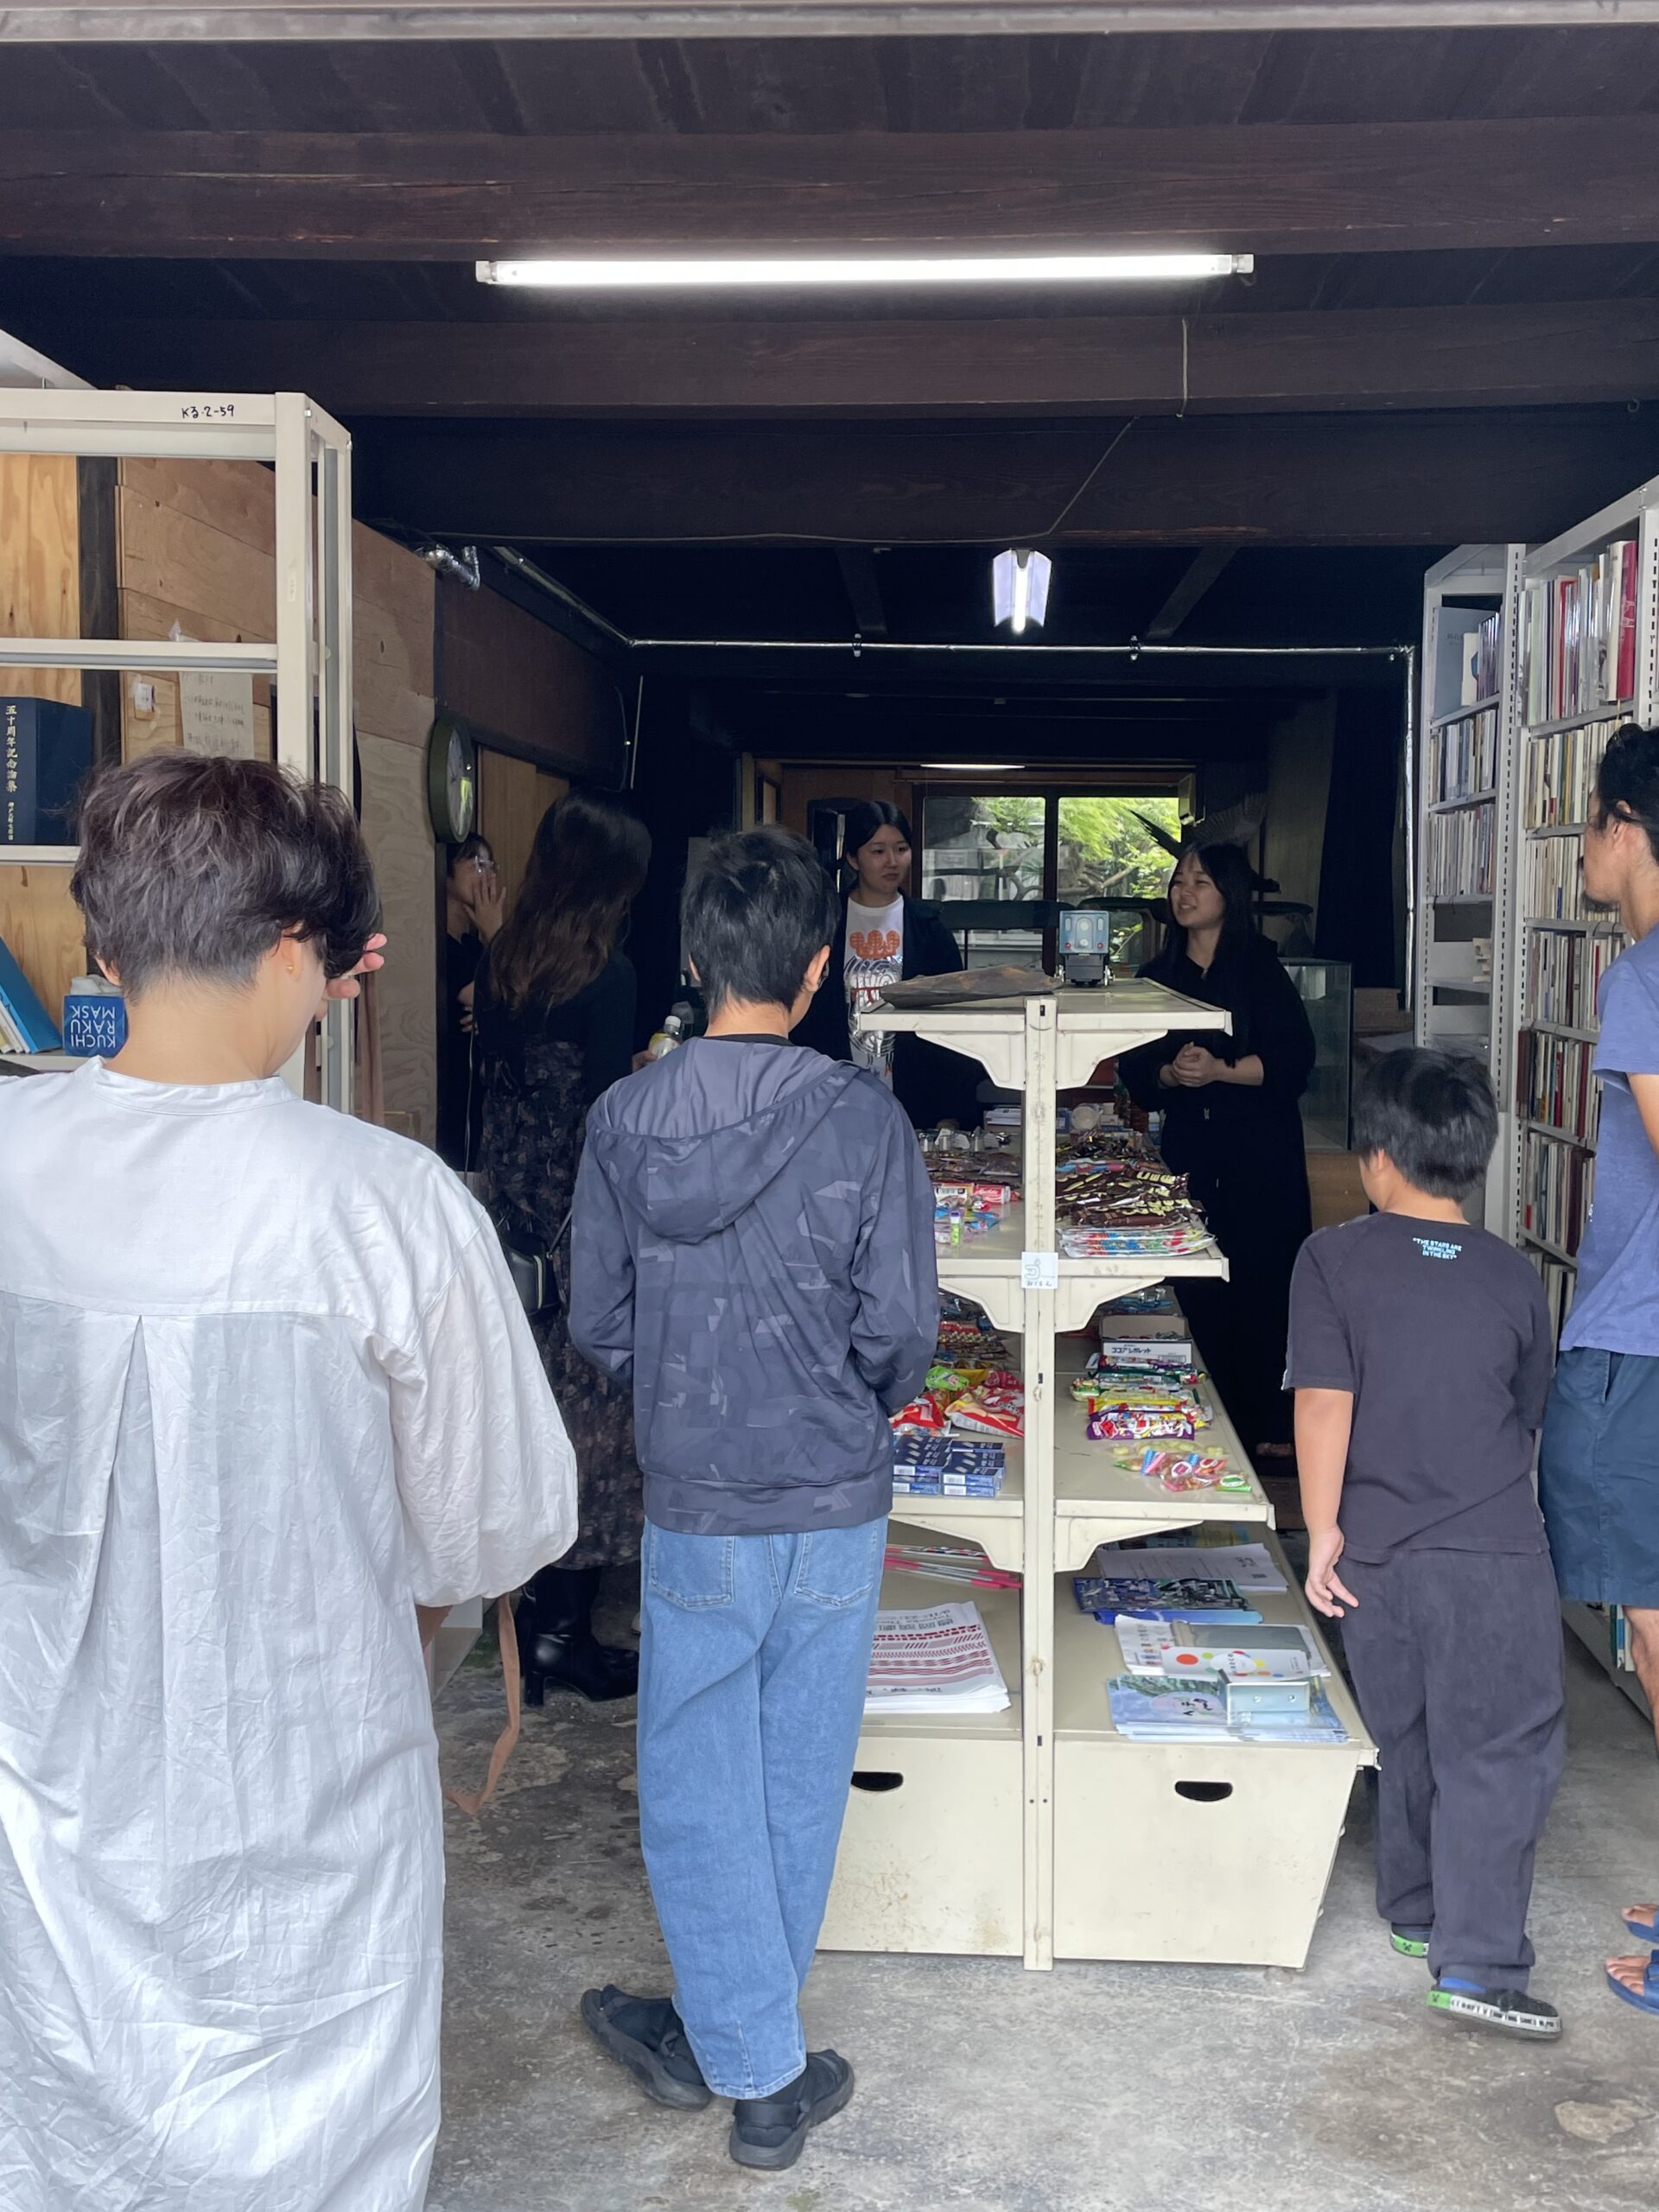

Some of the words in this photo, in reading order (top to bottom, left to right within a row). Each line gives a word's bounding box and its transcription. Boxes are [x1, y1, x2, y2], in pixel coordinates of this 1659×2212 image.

[69, 1005, 115, 1020] MASK
[70, 1019, 115, 1034] RAKU
[71, 1034, 116, 1048] KUCHI
